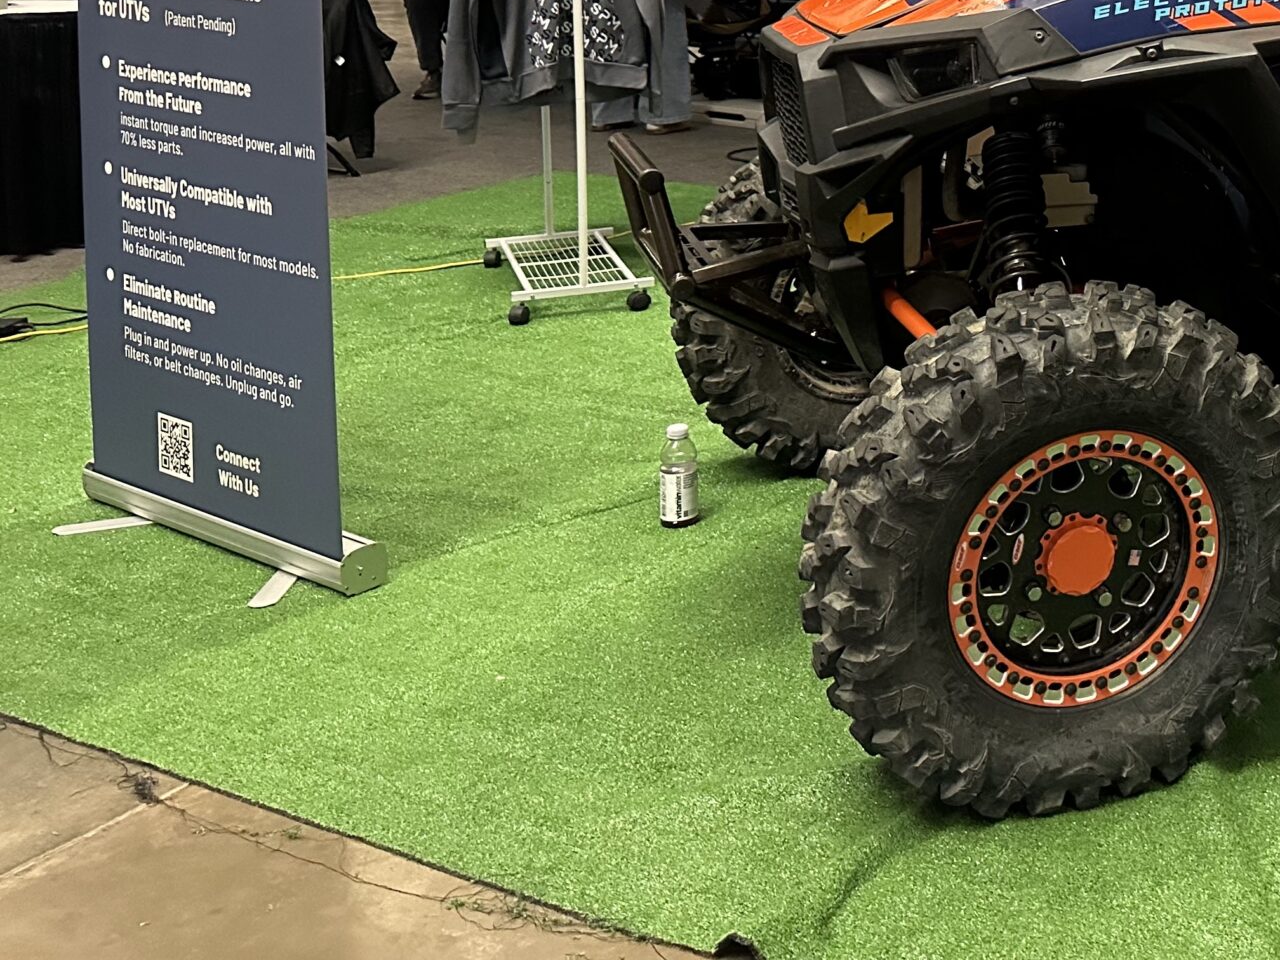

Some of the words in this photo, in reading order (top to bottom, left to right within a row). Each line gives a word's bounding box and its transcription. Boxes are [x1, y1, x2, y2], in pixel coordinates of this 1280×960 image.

[164, 9, 196, 29] (Patent
[198, 15, 236, 37] Pending)
[118, 59, 177, 86] Experience
[178, 71, 251, 98] Performance
[119, 87, 144, 105] From
[146, 90, 163, 108] the
[166, 93, 202, 115] Future
[120, 130, 137, 147] 70%
[139, 134, 156, 151] less
[158, 138, 184, 156] parts.
[150, 117, 179, 137] torque
[181, 123, 197, 140] and
[199, 126, 243, 148] increased
[245, 138, 277, 156] power,
[279, 142, 293, 157] all
[295, 145, 316, 161] with
[121, 166, 178, 199] Universally
[180, 178, 244, 209] Compatible
[246, 195, 272, 216] with
[121, 190, 145, 212] Most
[147, 195, 176, 220] UTVs
[122, 220, 147, 240] Direct
[149, 226, 178, 246] bolt-in
[179, 234, 236, 262] replacement
[238, 248, 252, 265] for
[253, 253, 278, 270] most
[279, 257, 319, 280] models.
[122, 239, 133, 255] No
[134, 241, 186, 268] fabrication.
[123, 274, 172, 304] Eliminate
[173, 287, 216, 315] Routine
[123, 299, 192, 333] Maintenance
[124, 326, 143, 348] Plug
[144, 331, 153, 348] in
[153, 334, 170, 352] and
[170, 340, 199, 361] power
[200, 348, 214, 365] up.
[216, 352, 229, 370] No
[231, 356, 243, 374] oil
[244, 361, 287, 389] changes,
[288, 373, 302, 391] air
[124, 345, 152, 367] filters,
[153, 352, 164, 369] or
[165, 356, 182, 375] belt
[183, 361, 224, 388] changes.
[225, 374, 258, 400] Unplug
[259, 383, 277, 403] and
[279, 390, 294, 409] go.
[215, 443, 260, 474] Connect
[218, 468, 244, 493] With
[245, 478, 260, 498] Us
